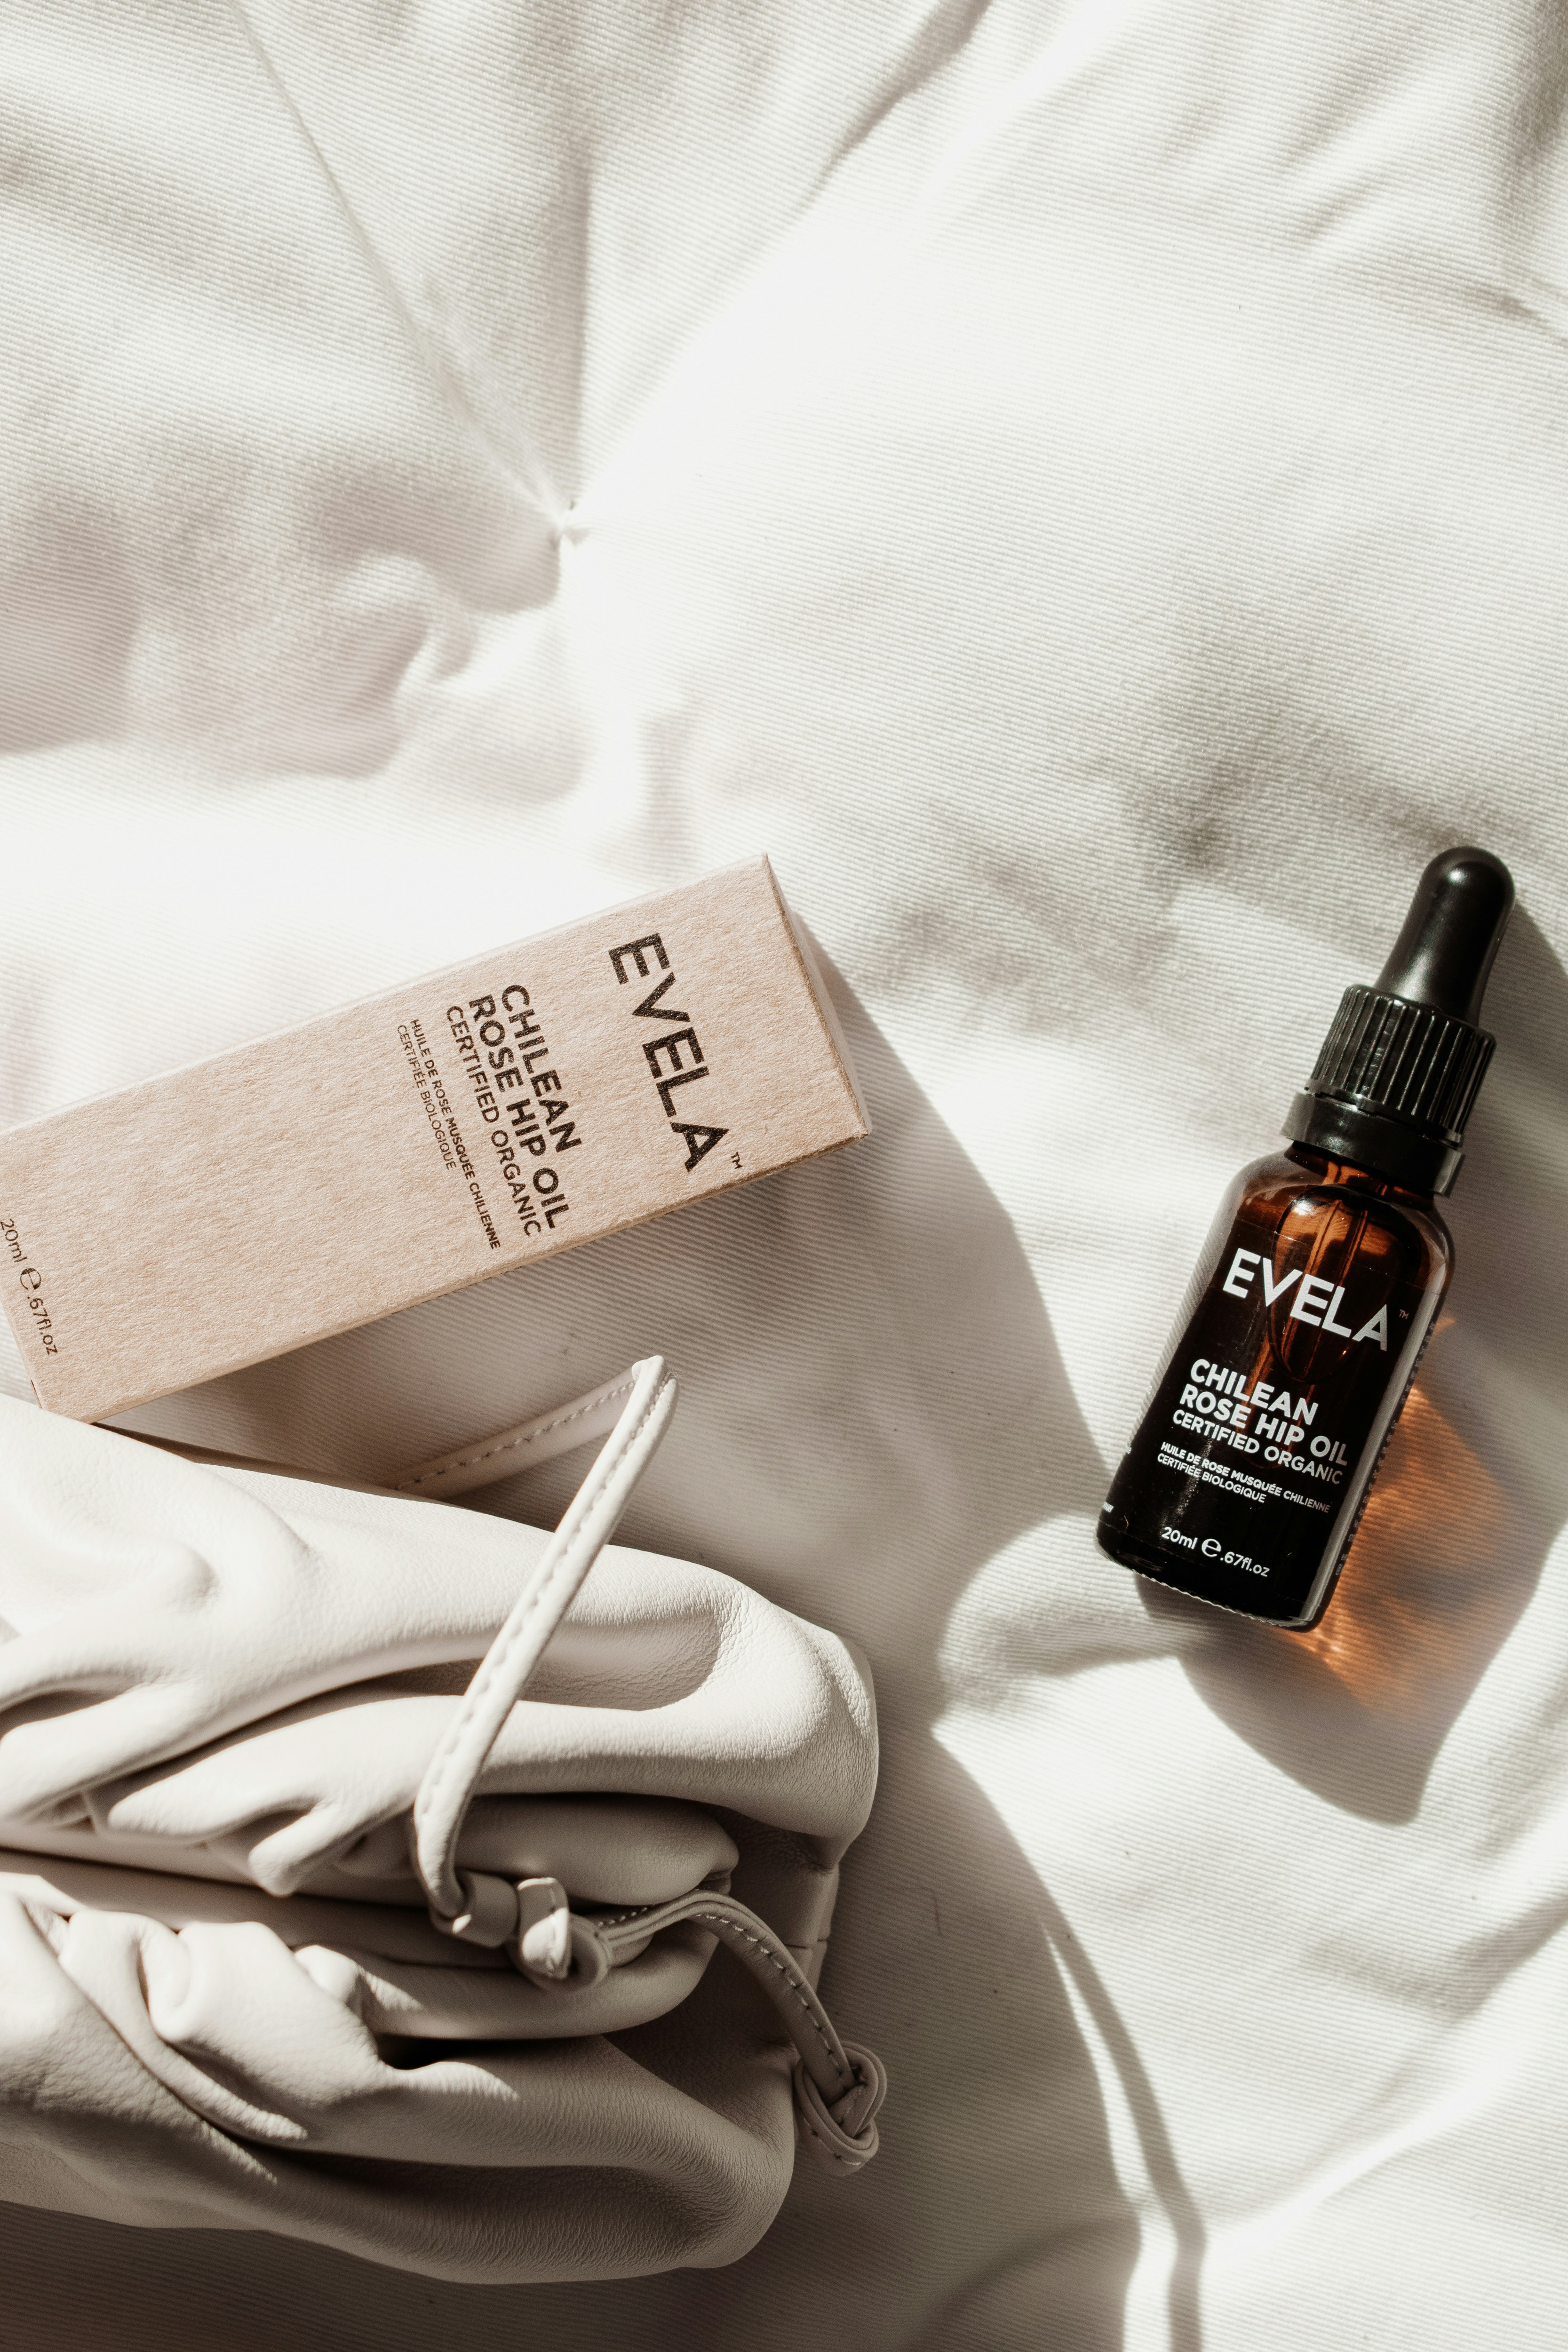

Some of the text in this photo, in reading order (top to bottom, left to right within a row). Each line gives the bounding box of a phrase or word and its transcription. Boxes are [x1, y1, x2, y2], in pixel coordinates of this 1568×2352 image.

[397, 1025, 456, 1170] CERTIFIÉE BIOLOGIQUE
[502, 984, 581, 1152] CHILEAN
[609, 933, 729, 1172] EVELA
[410, 1019, 501, 1249] HUILE DE ROSE MUSQUÉE CHILIENNE
[446, 1006, 541, 1236] CERTIFIED ORGANIC
[469, 994, 569, 1229] ROSE HIP OIL
[0, 1218, 27, 1263] 20ml
[1223, 1248, 1387, 1351] EVELA
[1179, 1383, 1347, 1466] ROSE HIP OIL
[1191, 1359, 1319, 1425] CHILEAN
[1157, 1453, 1266, 1503] CERTIFIÉE BIOLOGIQUE
[1161, 1442, 1330, 1513] HUILE DE ROSE MUSQUÉE CHILIENNE
[1173, 1409, 1343, 1484] CERTIFIED ORGANIC
[1162, 1526, 1198, 1549] 20ml
